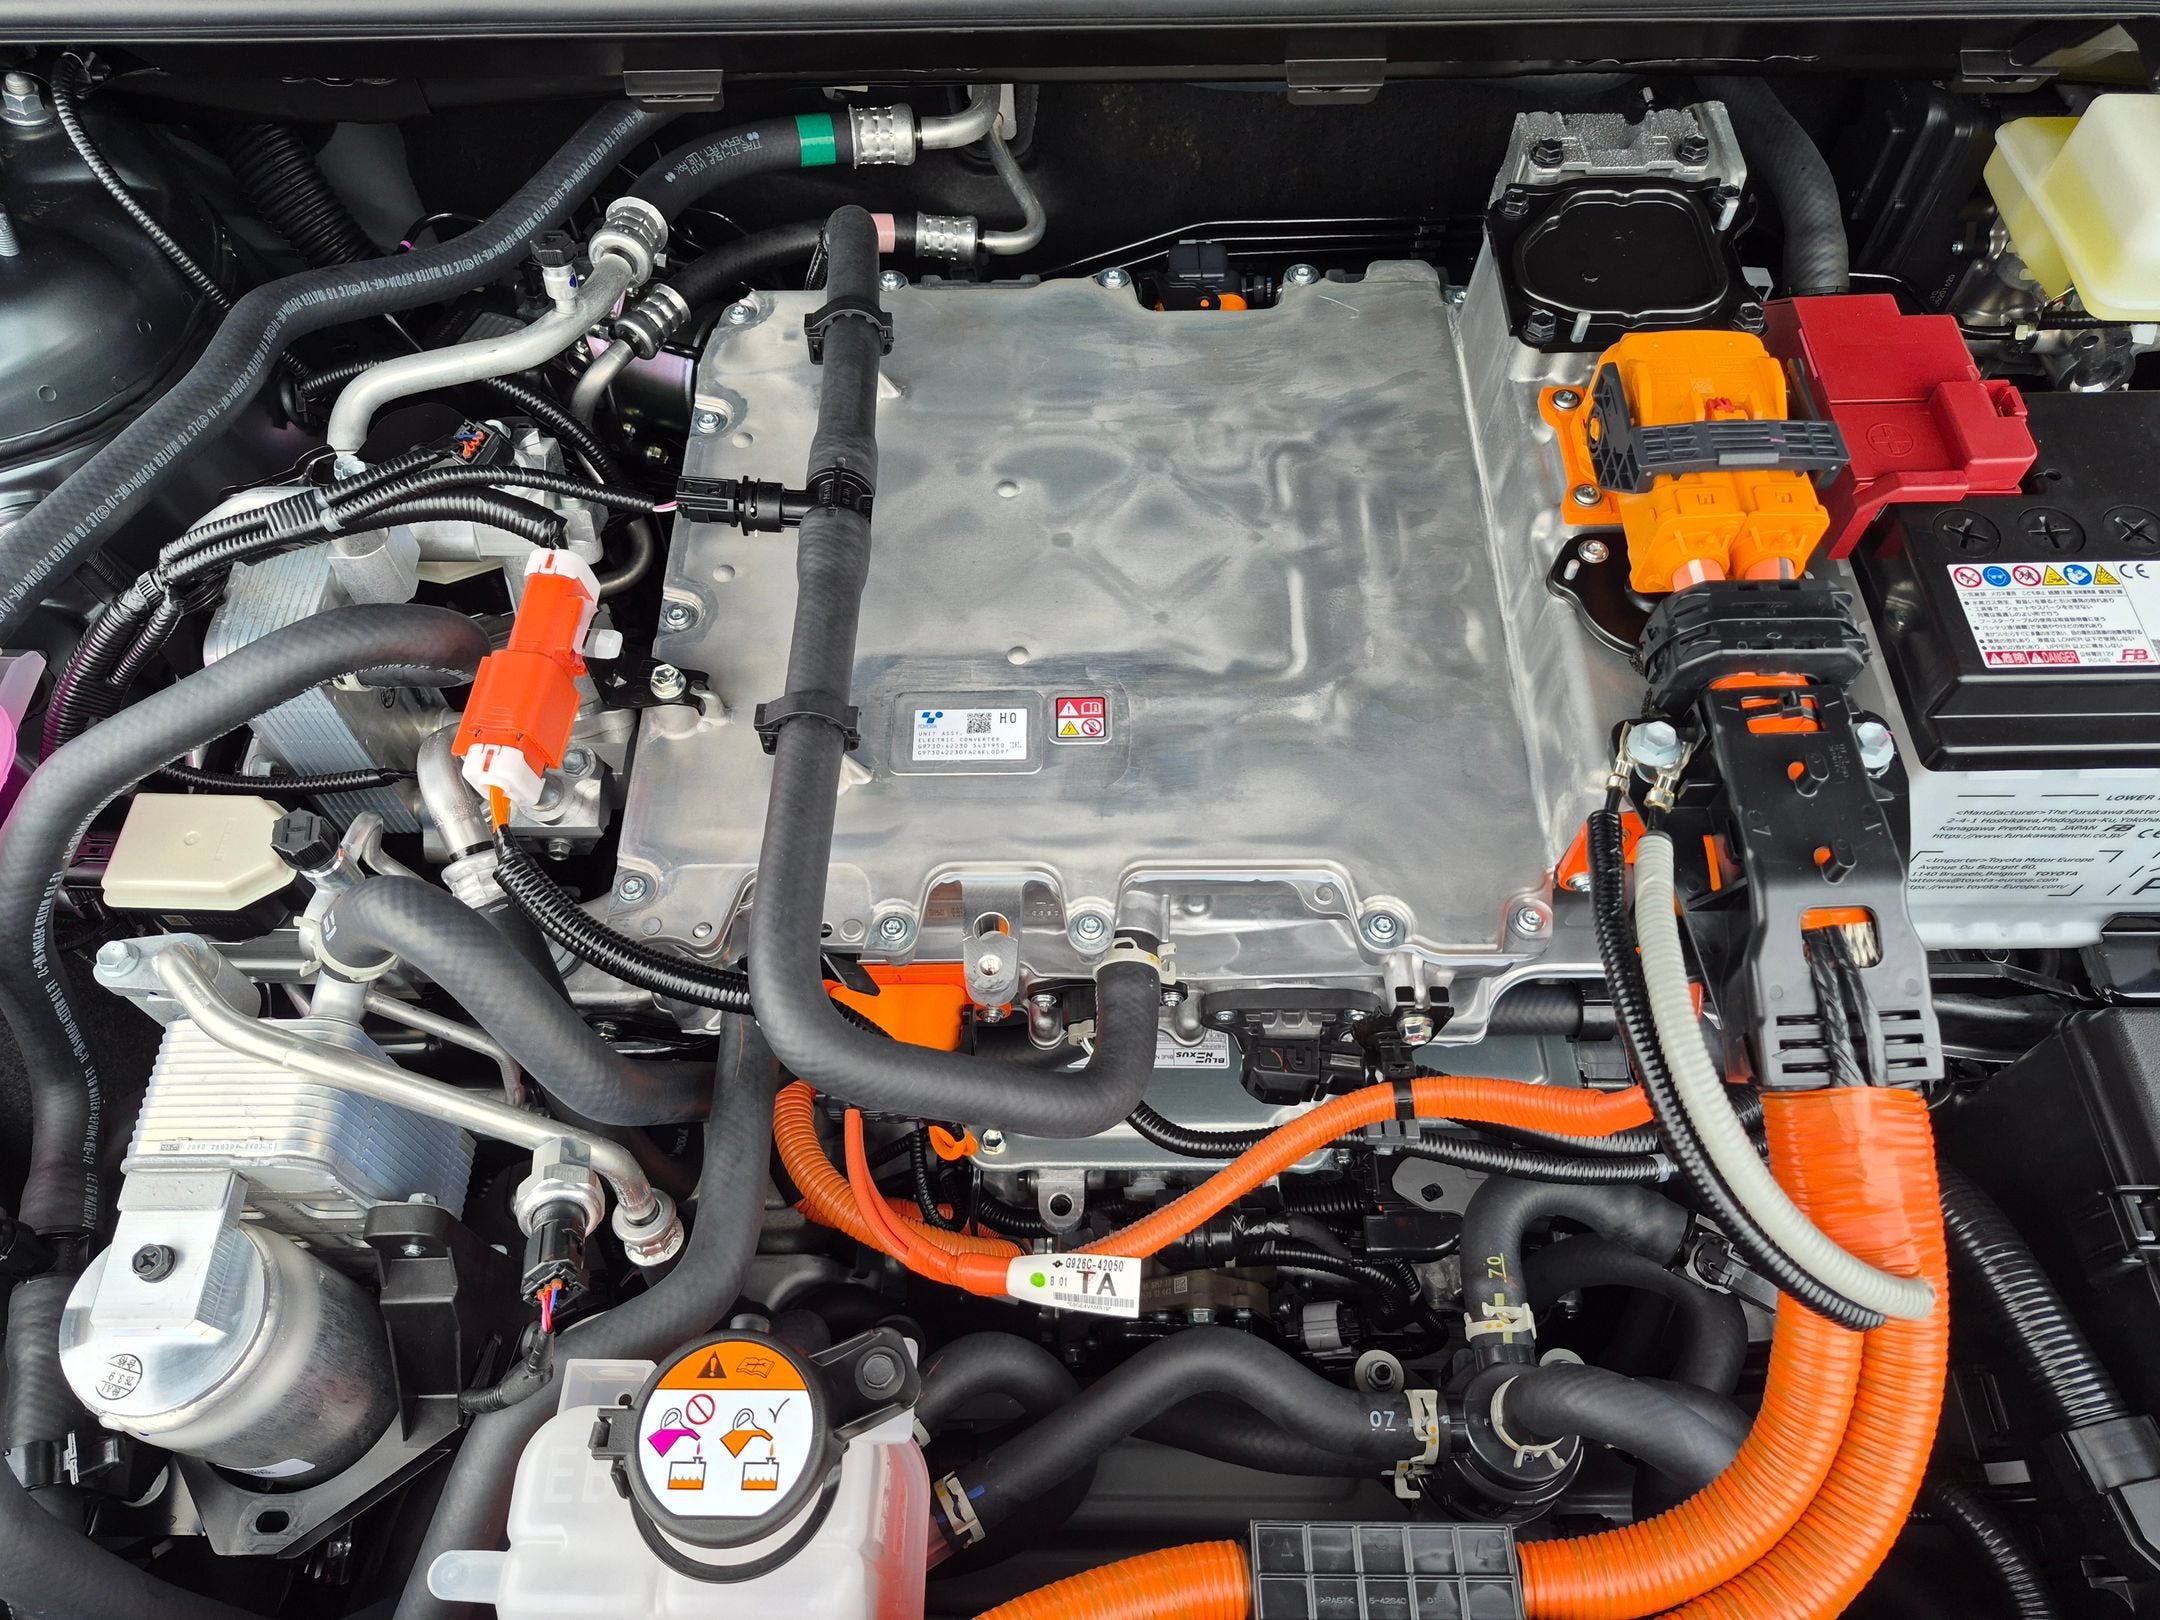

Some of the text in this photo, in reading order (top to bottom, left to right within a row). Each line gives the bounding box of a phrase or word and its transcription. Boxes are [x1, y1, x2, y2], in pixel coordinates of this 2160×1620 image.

[2042, 651, 2080, 664] DANGER
[2122, 649, 2148, 660] FB
[1065, 1257, 1124, 1272] G926C-42050
[1076, 1270, 1117, 1296] TA
[1369, 1410, 1395, 1428] 07
